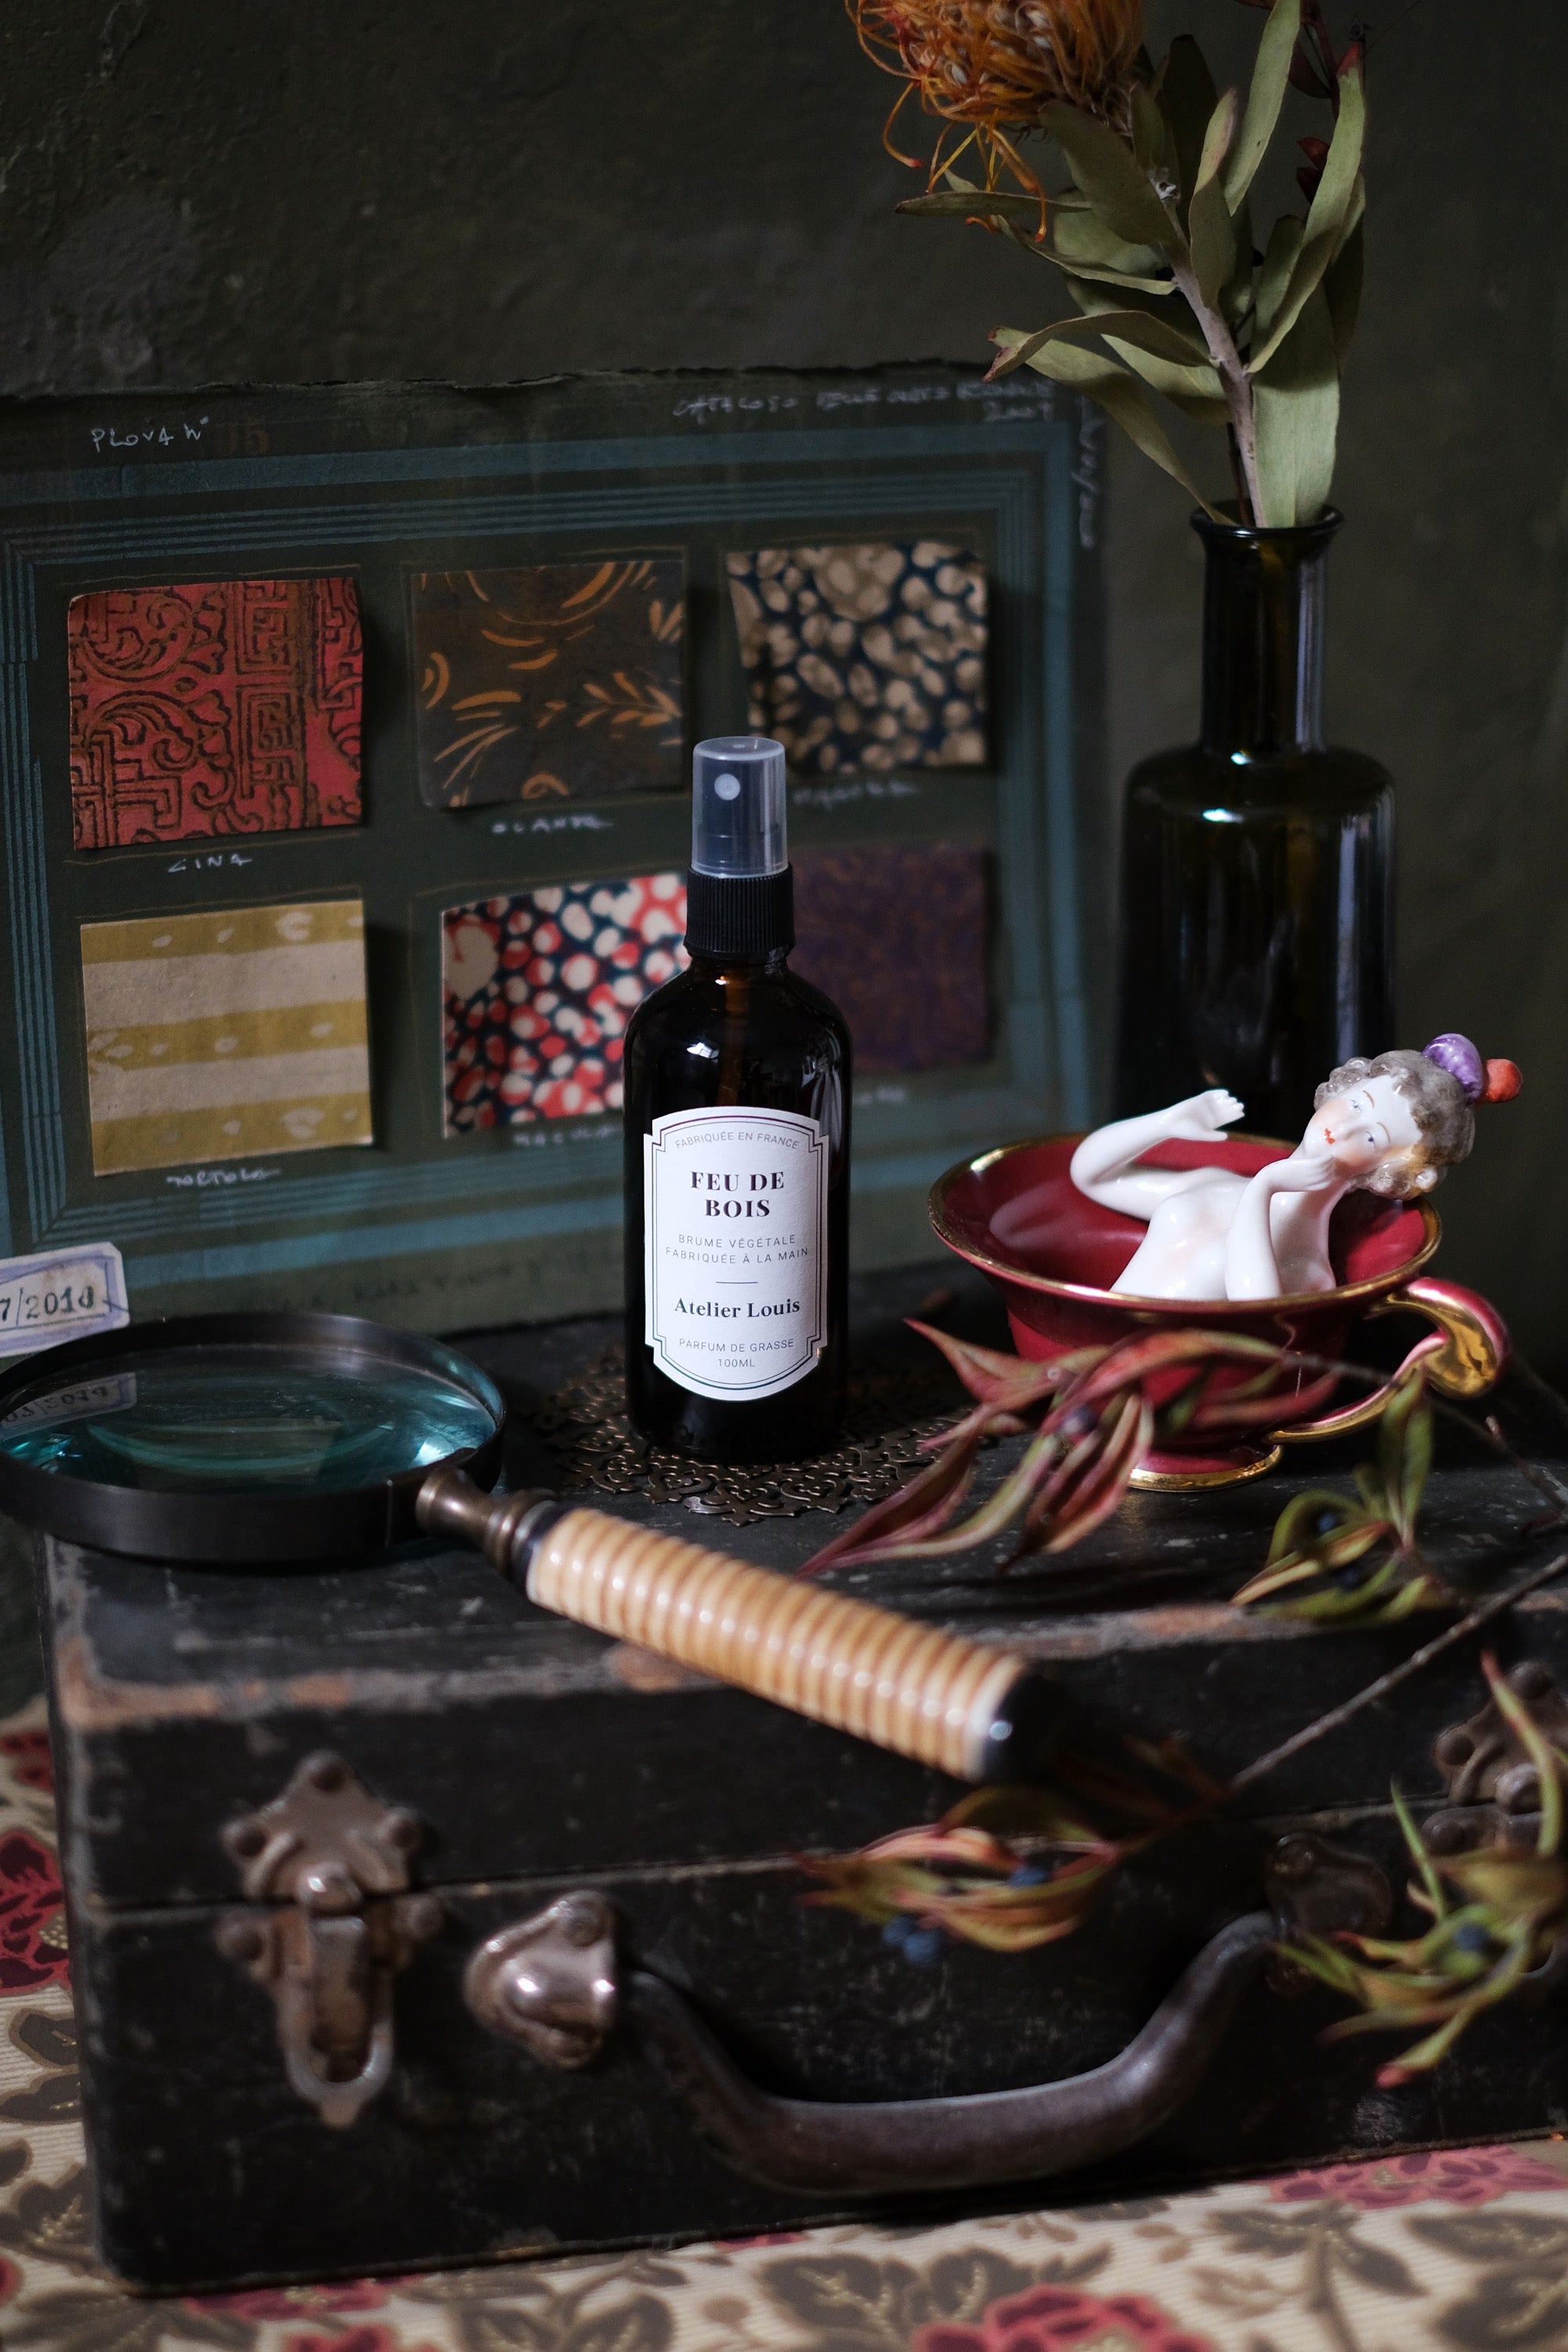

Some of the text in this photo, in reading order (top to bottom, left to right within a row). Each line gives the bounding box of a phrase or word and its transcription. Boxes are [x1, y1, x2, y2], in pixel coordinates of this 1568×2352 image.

[675, 1131, 800, 1150] FABRIQUÉE EN FRANCE
[690, 1171, 785, 1192] FEU DE
[704, 1199, 771, 1218] BOIS
[678, 1234, 797, 1249] BRUME VÉGÉTALE
[666, 1247, 808, 1264] FABRIQUÉE À LA MAIN
[673, 1298, 800, 1319] Atelier Louis
[679, 1338, 794, 1352] PARFUM DE GRASSE
[717, 1358, 756, 1368] 100ML
